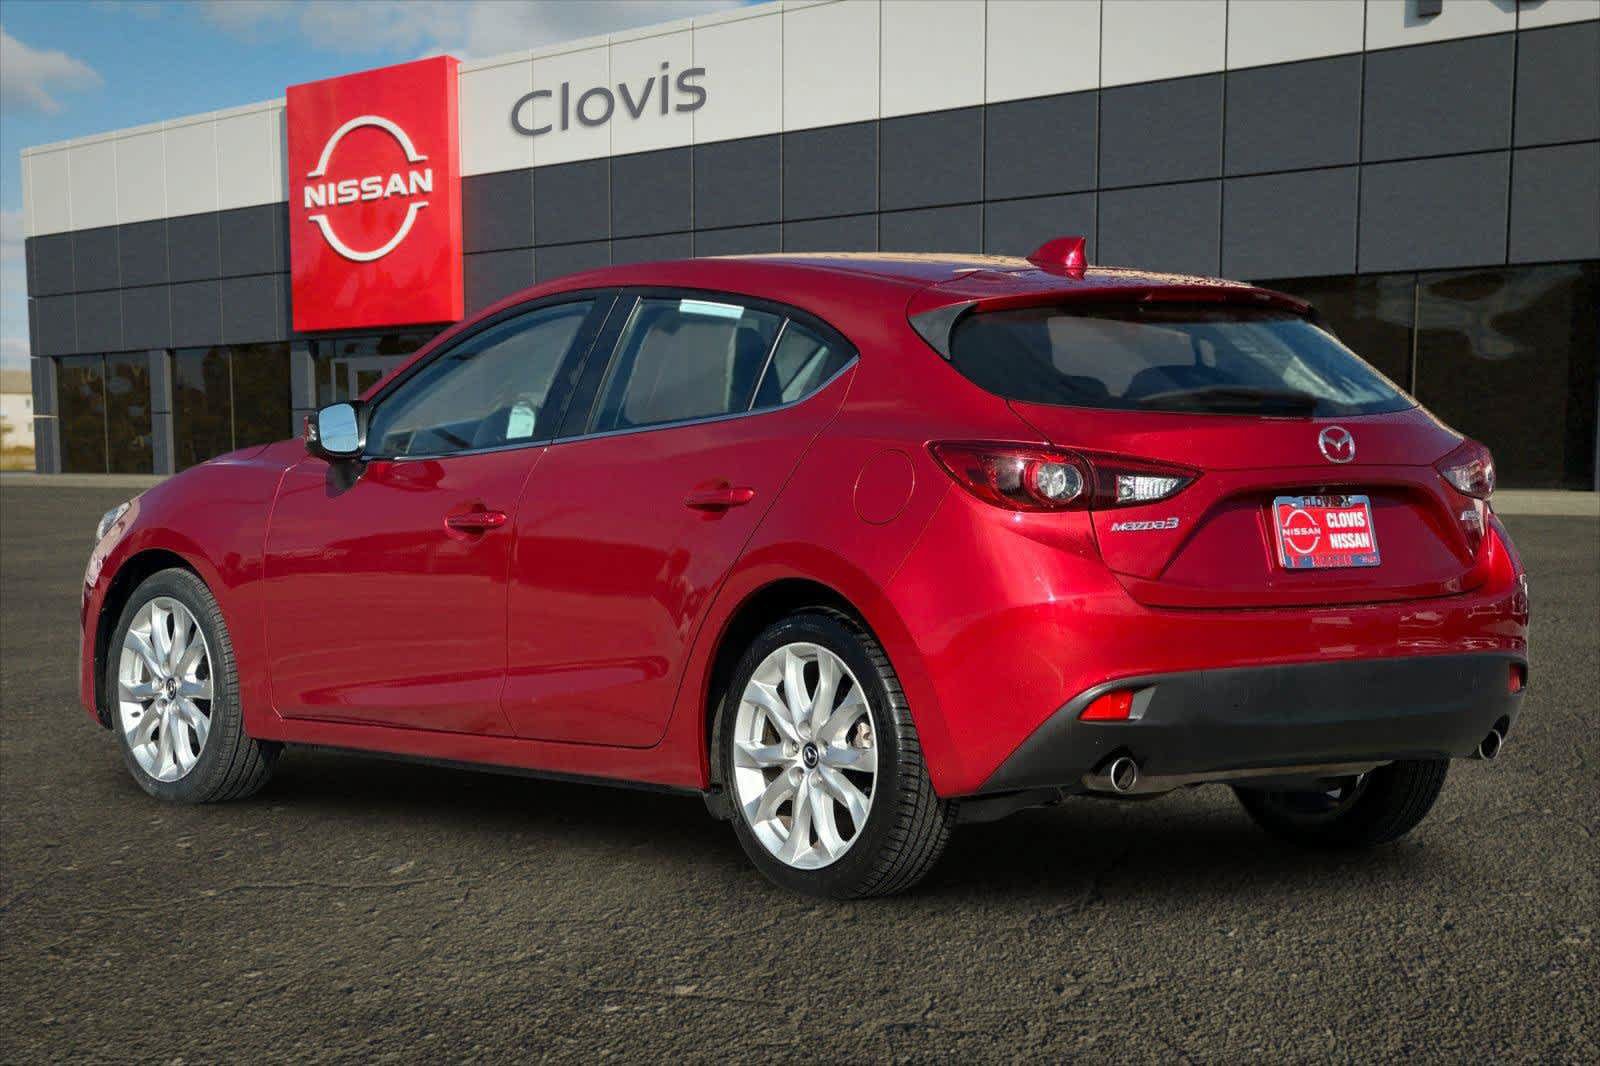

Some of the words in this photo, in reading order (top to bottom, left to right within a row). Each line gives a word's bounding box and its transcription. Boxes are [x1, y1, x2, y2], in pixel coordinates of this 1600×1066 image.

[511, 61, 707, 136] Clovis
[304, 168, 433, 208] NISSAN
[1326, 511, 1365, 528] CLOVIS
[1282, 527, 1321, 537] NISSAN
[1329, 532, 1370, 549] NISSAN
